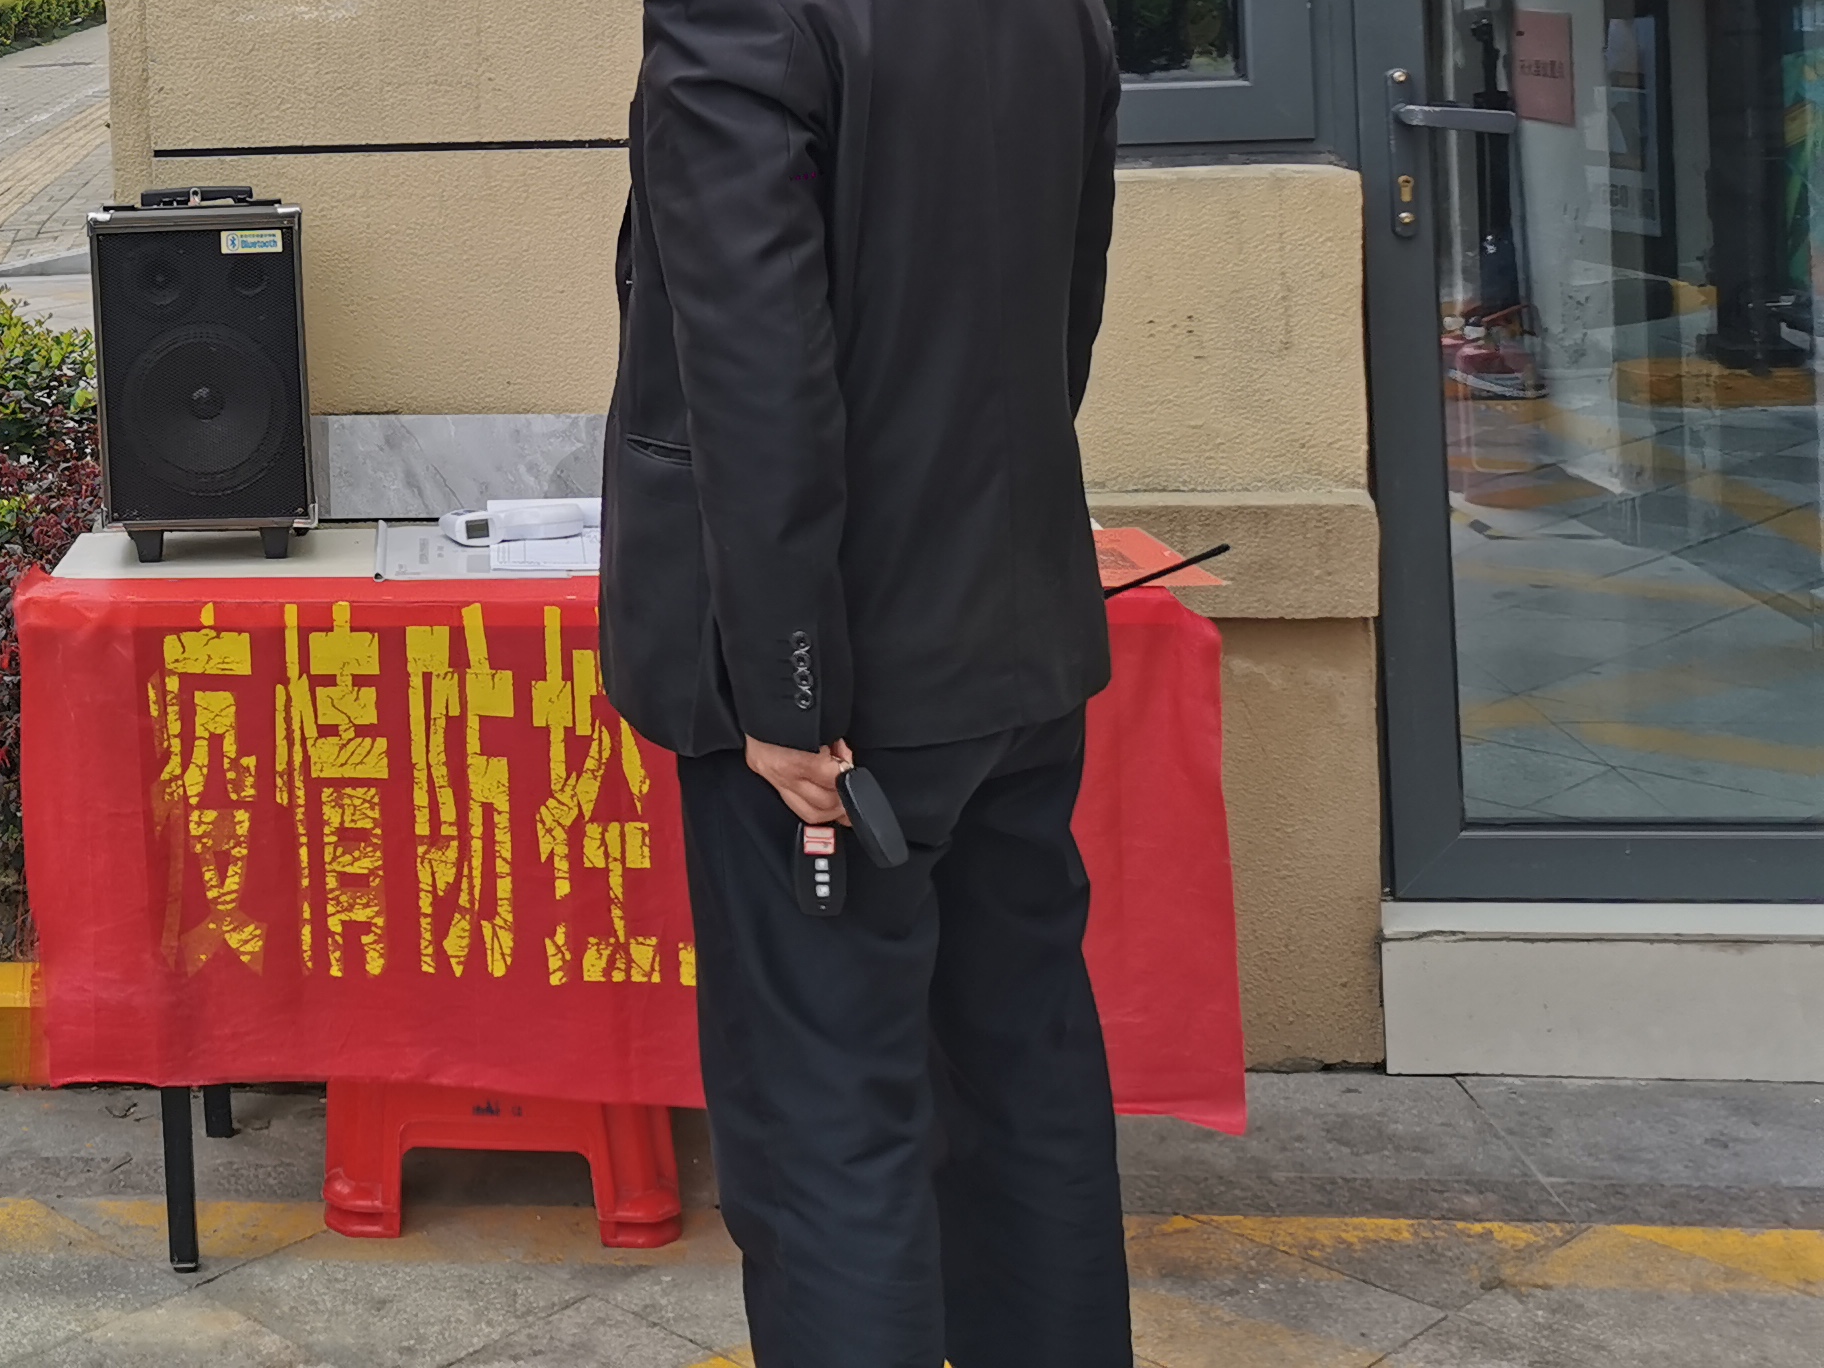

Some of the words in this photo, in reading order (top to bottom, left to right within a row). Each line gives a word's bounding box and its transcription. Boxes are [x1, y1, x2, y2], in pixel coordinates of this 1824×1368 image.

[240, 239, 278, 249] Bluetooth
[147, 600, 697, 987] 疫情防控
